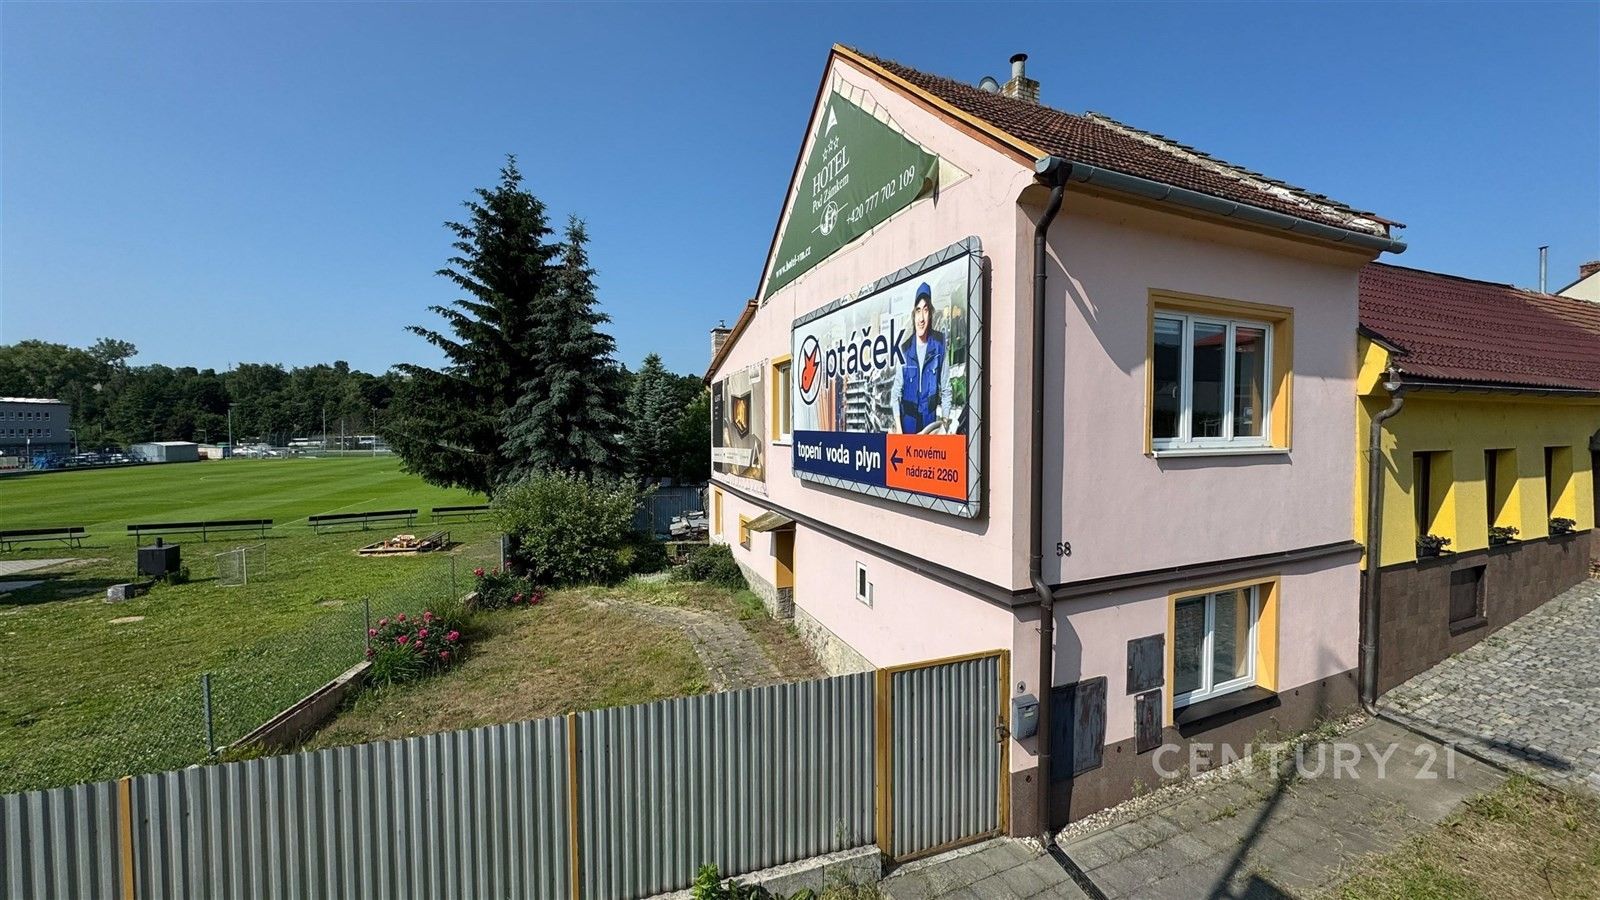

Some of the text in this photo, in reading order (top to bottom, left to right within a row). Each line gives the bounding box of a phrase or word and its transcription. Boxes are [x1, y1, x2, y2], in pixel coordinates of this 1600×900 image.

[812, 145, 850, 198] HOTEL
[812, 194, 823, 213] Pod
[846, 165, 915, 225] +420 777 702 109
[824, 318, 906, 388] ptáček
[797, 441, 881, 472] topení voda plyn
[905, 445, 947, 460] K novému
[905, 466, 959, 483] nádraží 2260
[1056, 541, 1072, 557] 58
